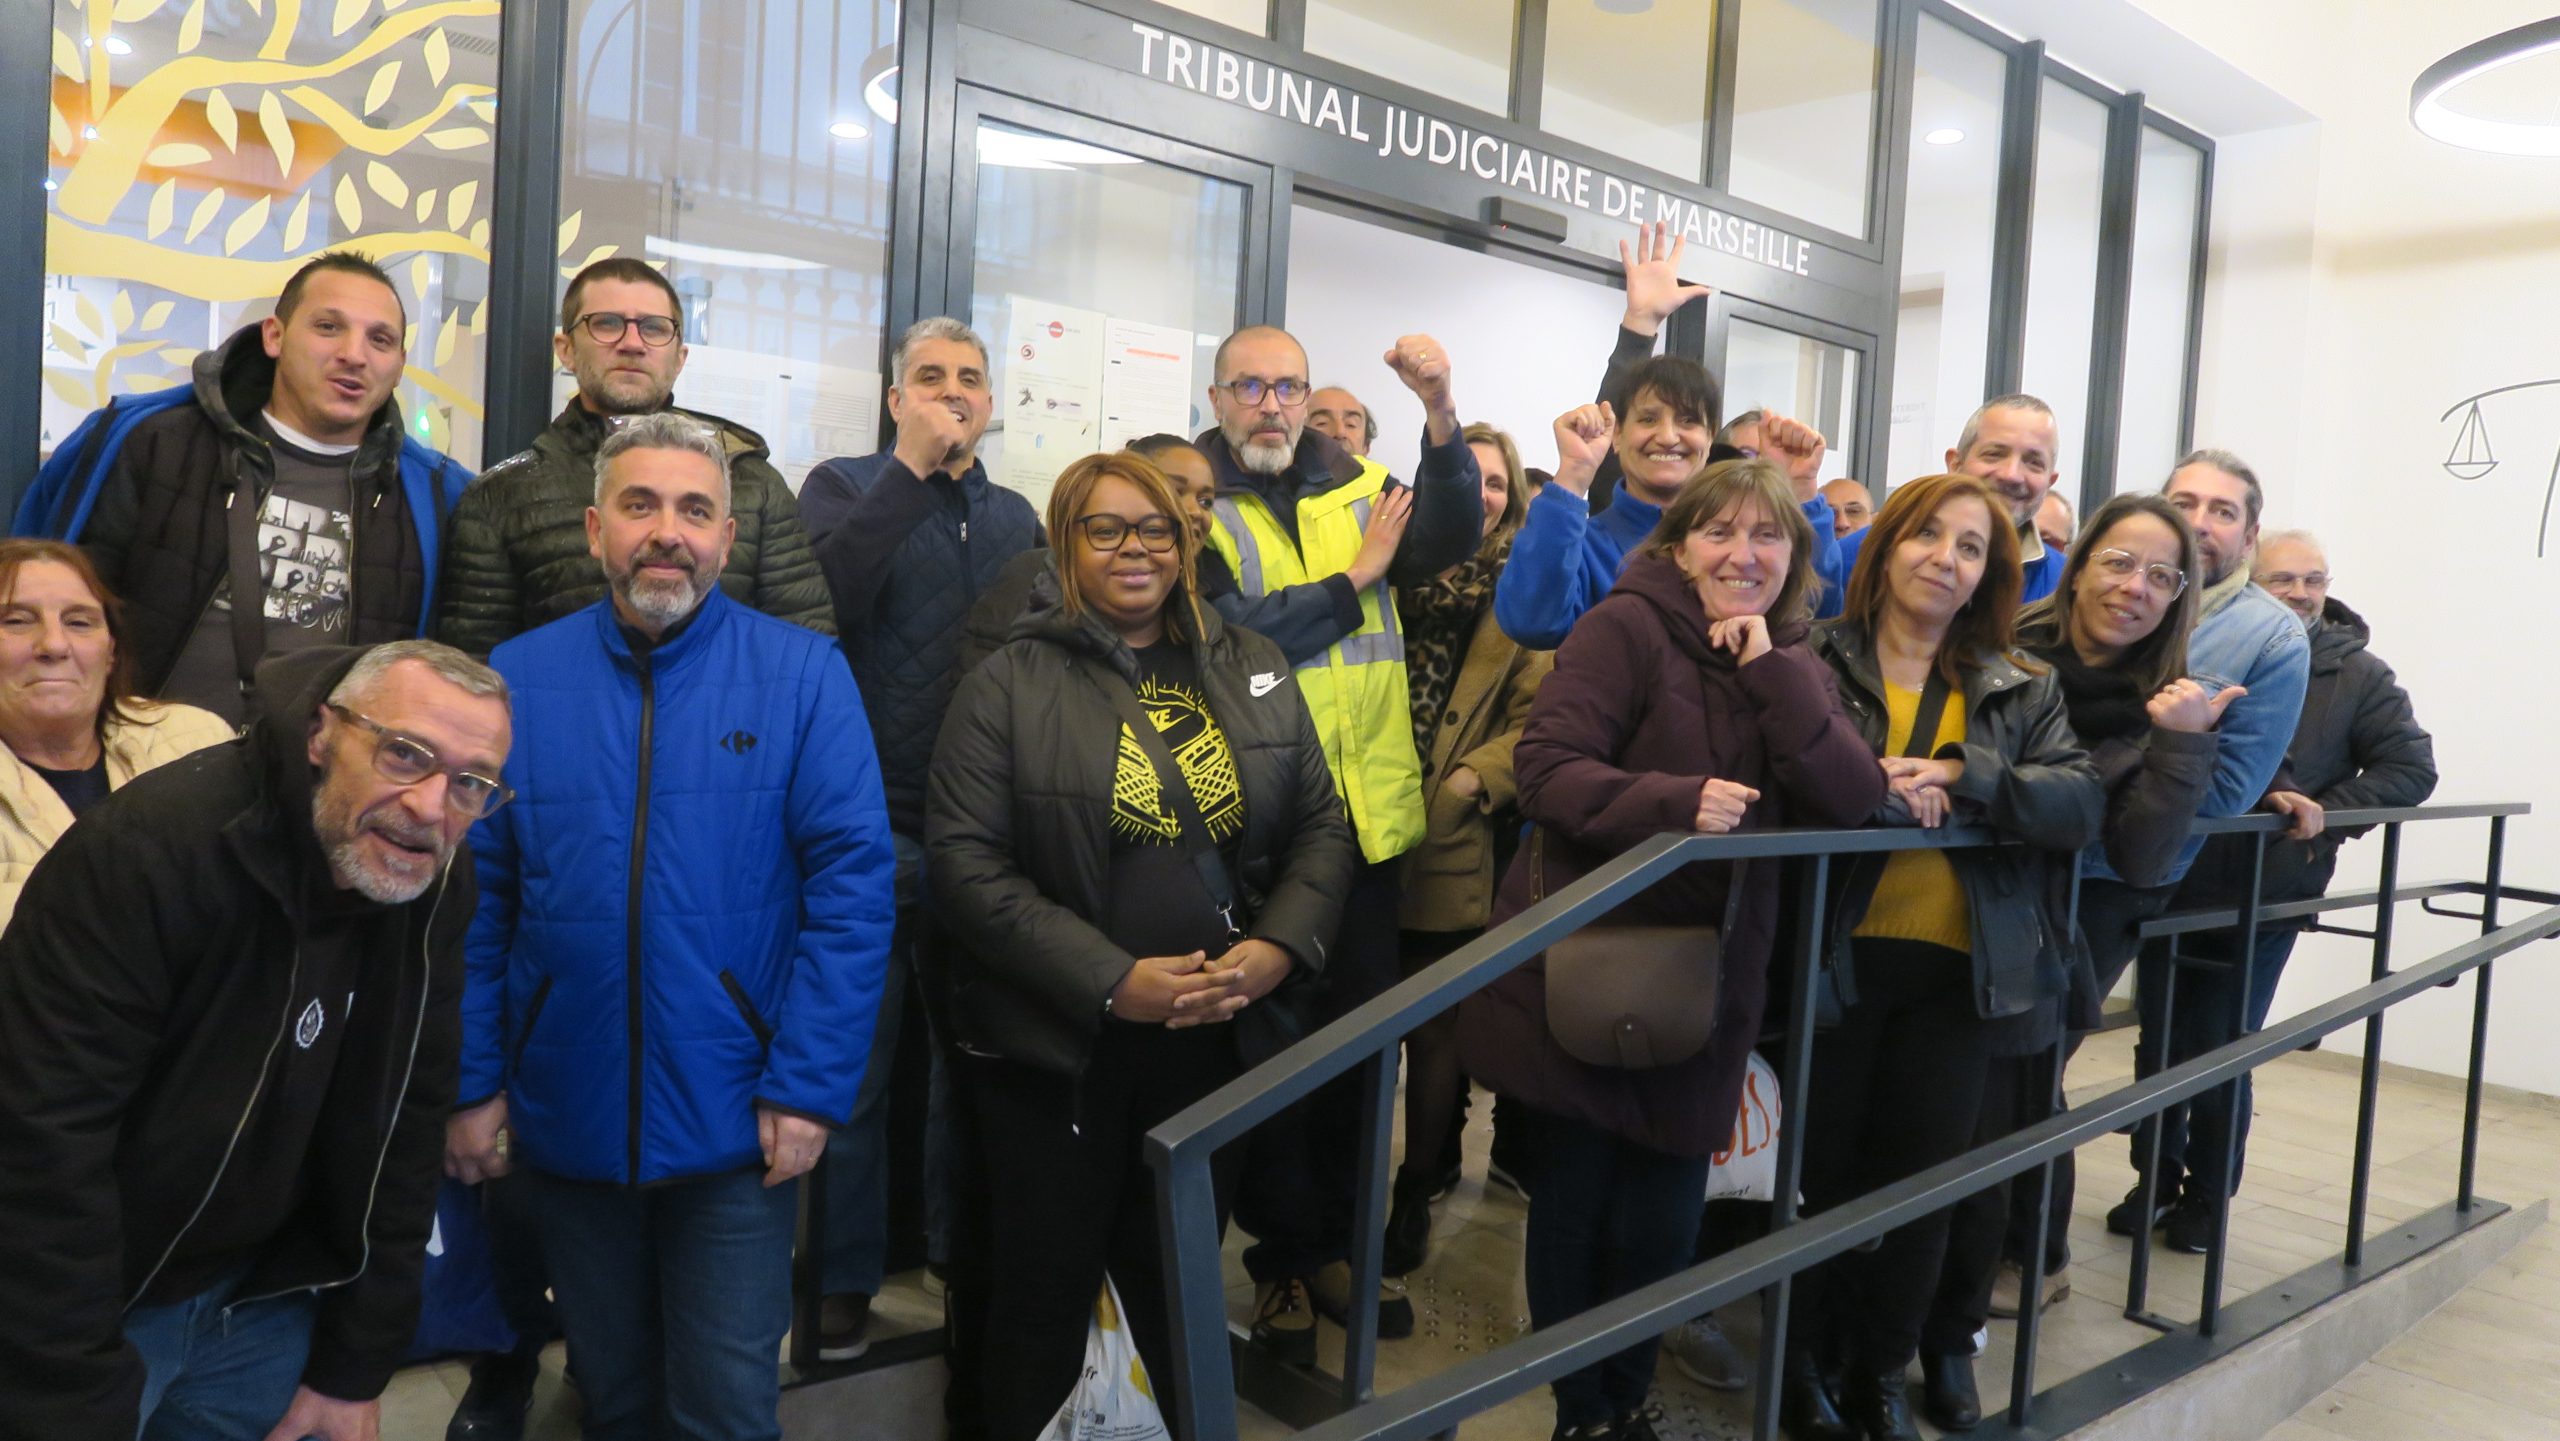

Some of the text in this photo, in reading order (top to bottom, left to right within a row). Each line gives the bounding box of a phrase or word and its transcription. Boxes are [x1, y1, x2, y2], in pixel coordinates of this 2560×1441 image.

[1132, 23, 1811, 277] TRIBUNAL JUDICIAIRE DE MARSEILLE
